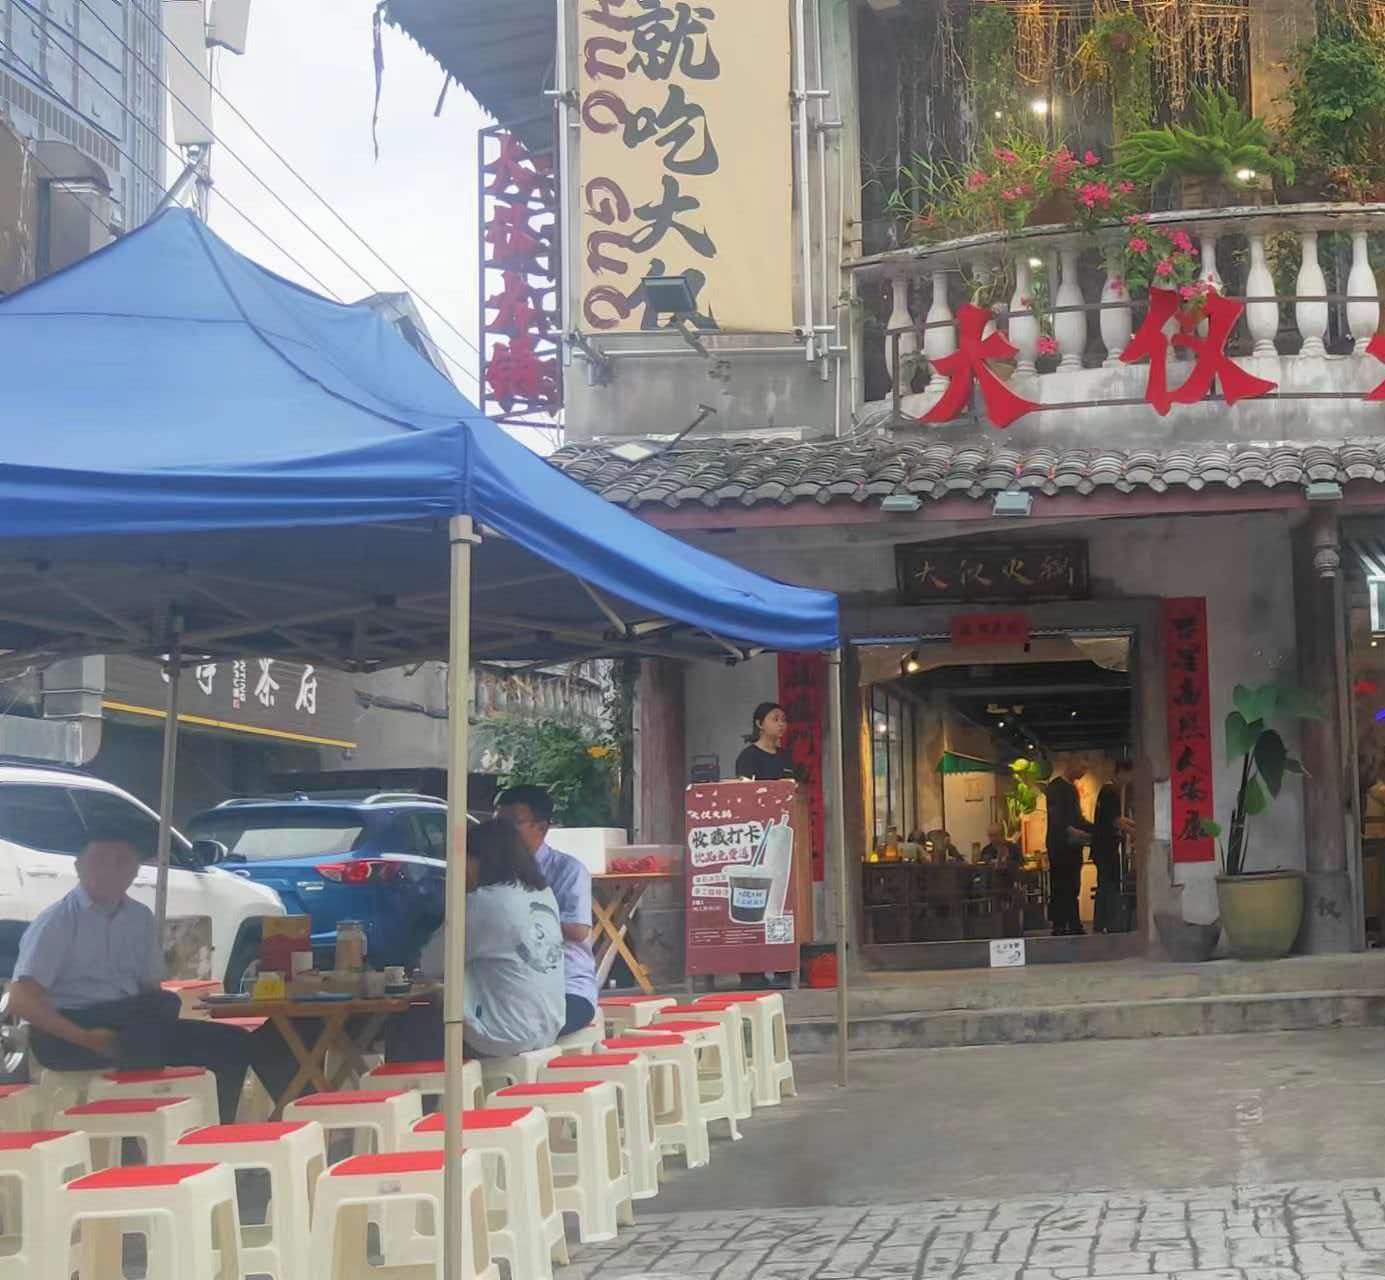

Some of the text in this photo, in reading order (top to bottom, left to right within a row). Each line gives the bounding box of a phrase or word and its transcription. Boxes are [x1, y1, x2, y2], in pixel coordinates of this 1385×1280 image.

[583, 176, 632, 330] GUO
[692, 825, 761, 848] 收藏打卡
